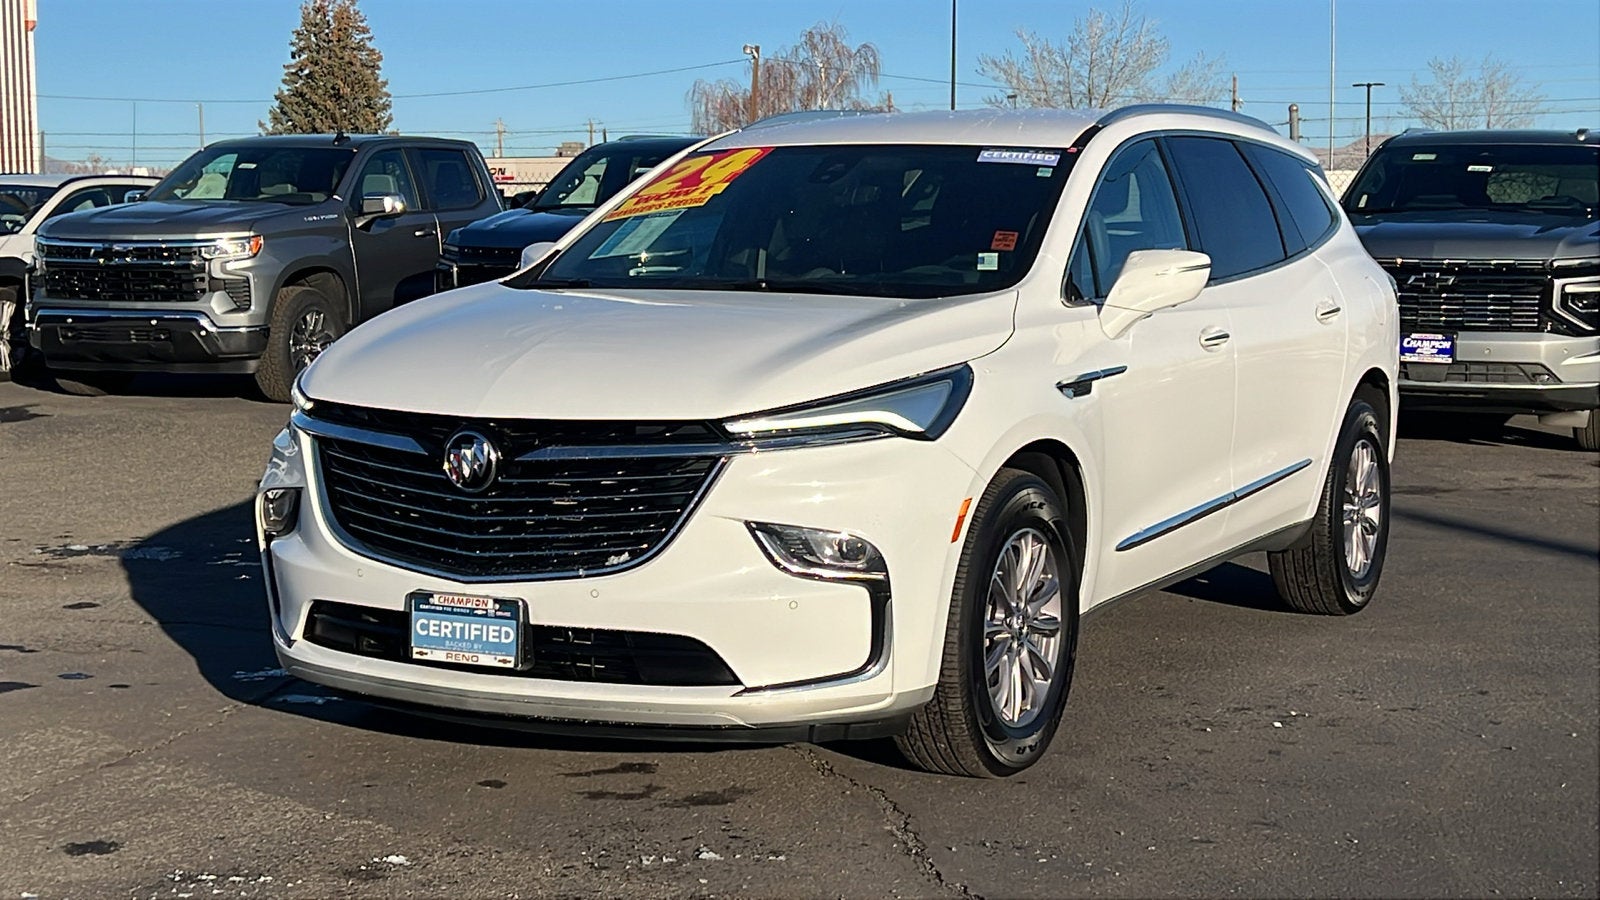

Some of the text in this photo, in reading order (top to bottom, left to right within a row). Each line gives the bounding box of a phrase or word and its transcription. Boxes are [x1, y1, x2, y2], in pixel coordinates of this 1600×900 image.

[983, 151, 1055, 161] CERTIFIED
[637, 148, 763, 197] 24
[1403, 338, 1452, 349] CHAMPION
[437, 595, 489, 608] CHAMPION
[416, 618, 515, 644] CERTIFIED
[445, 652, 479, 663] RENO
